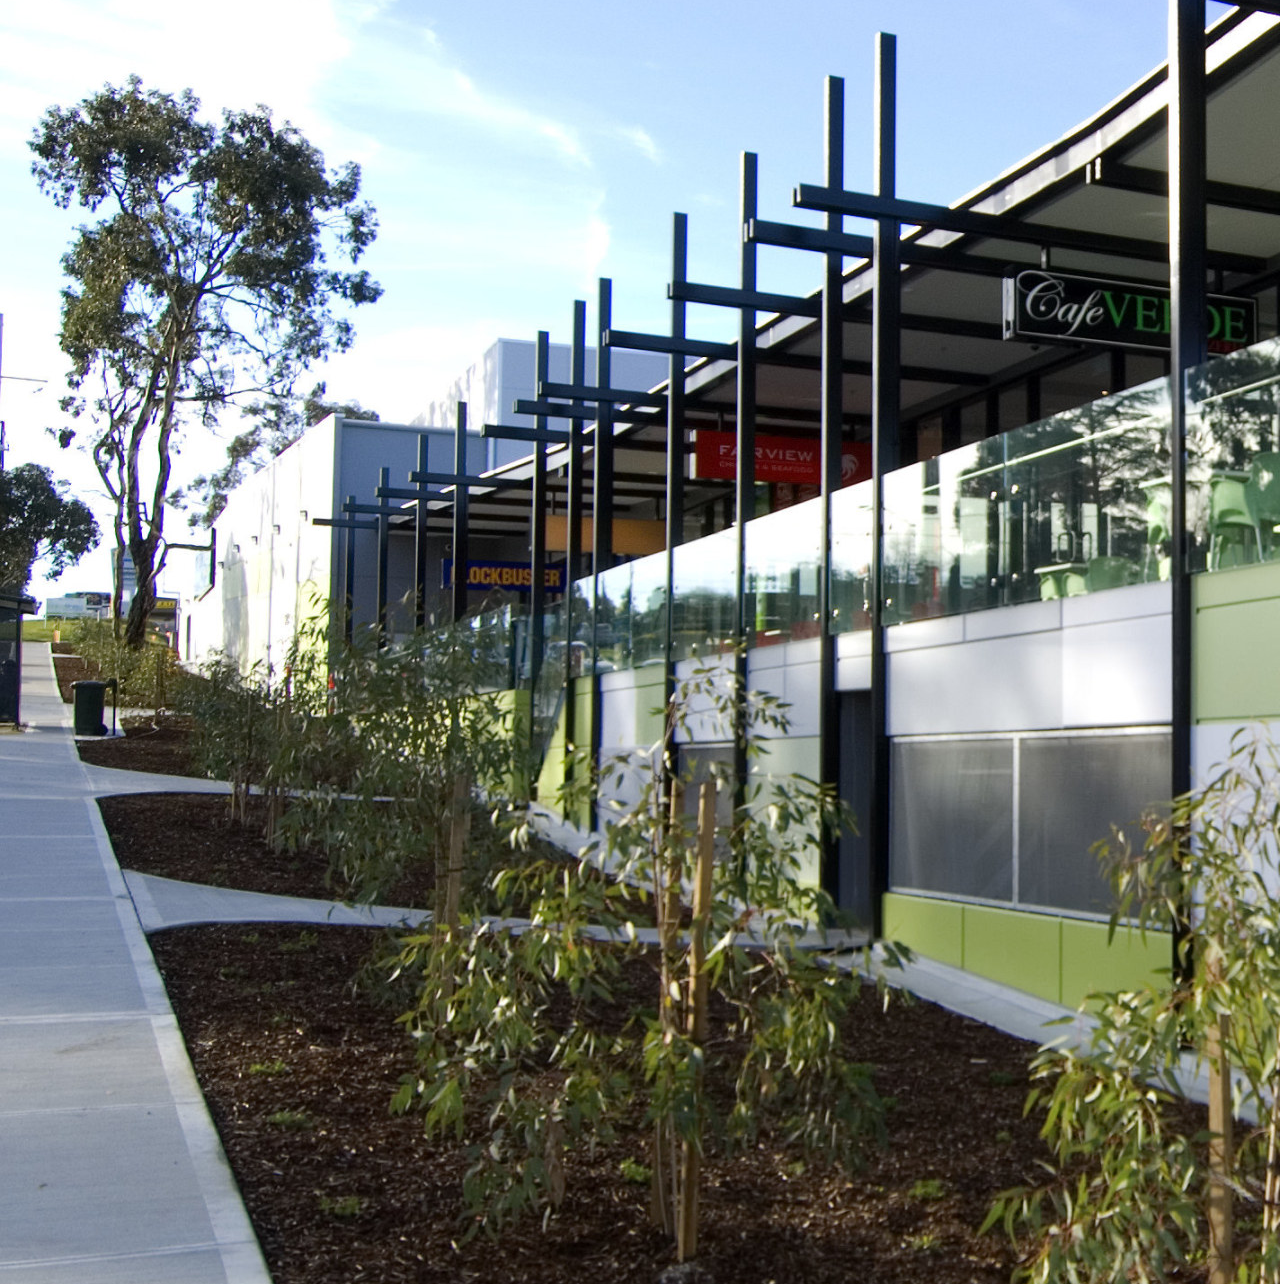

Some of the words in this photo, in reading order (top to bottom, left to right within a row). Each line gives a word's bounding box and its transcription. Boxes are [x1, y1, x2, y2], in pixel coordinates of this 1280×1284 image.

[1102, 291, 1248, 343] VEDE
[719, 445, 813, 462] FRVIEW
[450, 566, 560, 587] OCKBUSER
